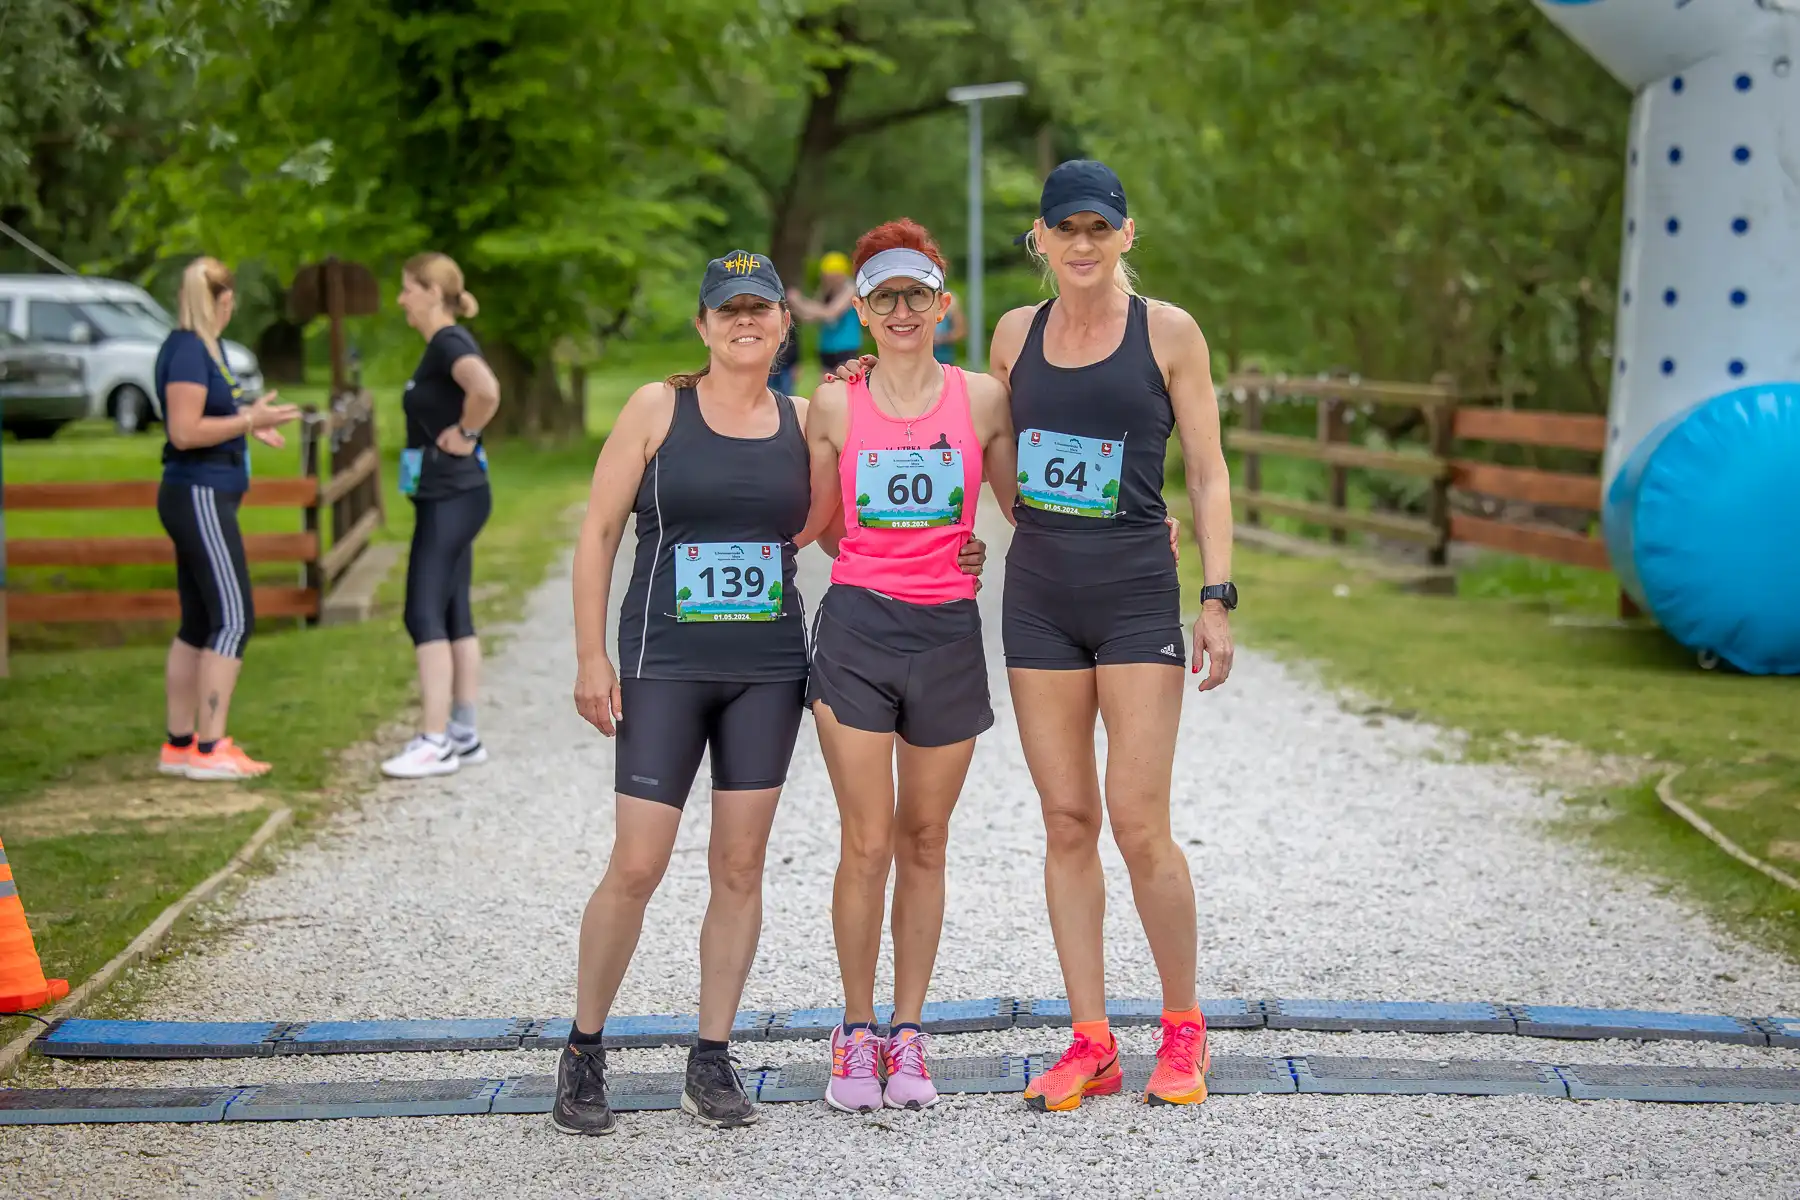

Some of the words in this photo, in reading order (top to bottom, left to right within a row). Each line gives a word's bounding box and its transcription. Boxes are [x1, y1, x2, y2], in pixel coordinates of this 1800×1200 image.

[888, 473, 933, 505] 60
[1044, 457, 1087, 492] 64
[891, 520, 930, 528] 01.05.2024.
[1044, 503, 1080, 515] 01.05.2024.
[698, 566, 765, 598] 139
